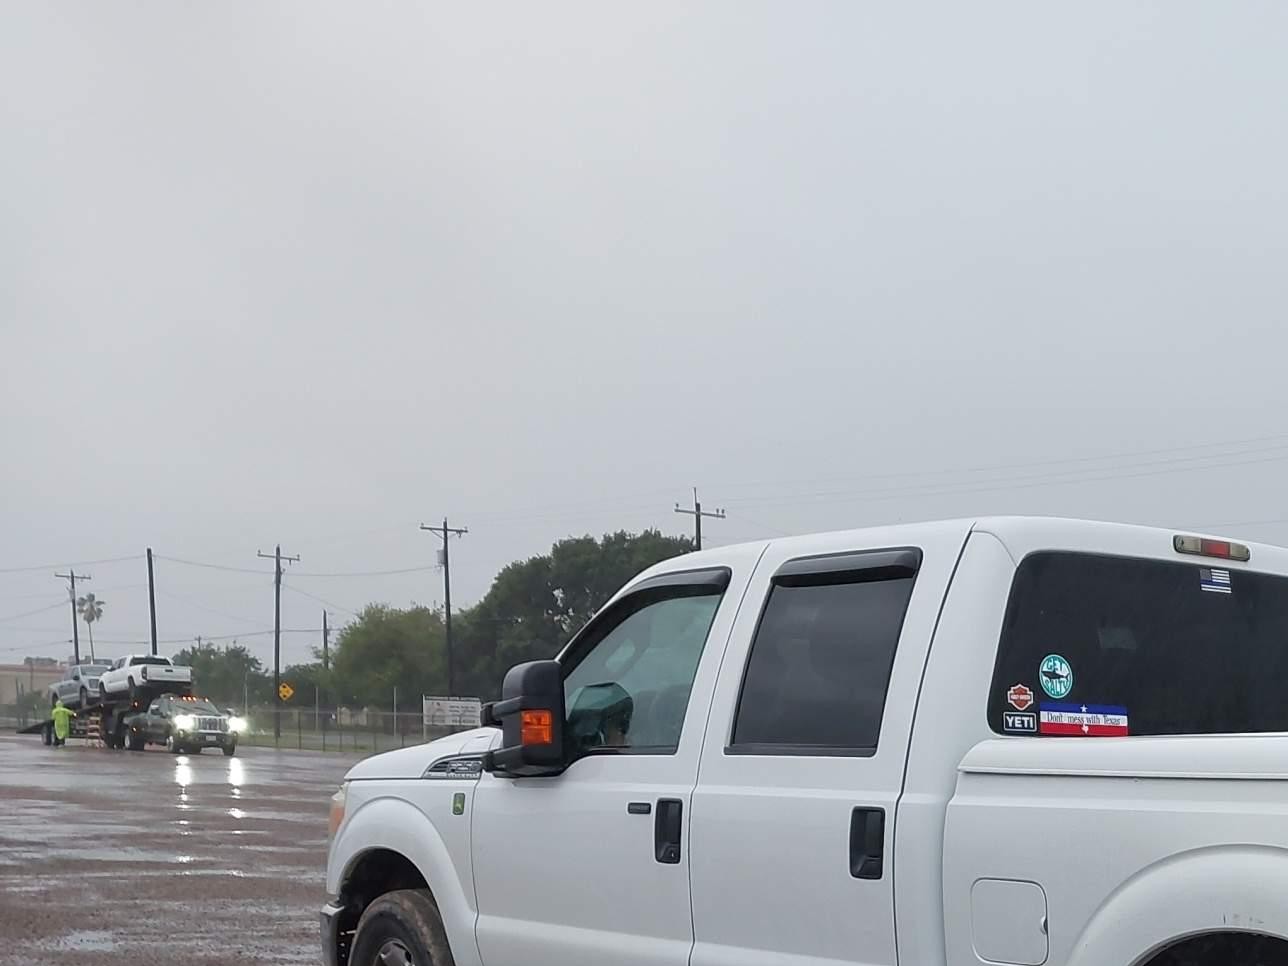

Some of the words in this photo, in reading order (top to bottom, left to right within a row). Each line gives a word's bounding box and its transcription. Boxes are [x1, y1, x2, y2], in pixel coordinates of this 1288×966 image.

[1045, 679, 1070, 696] SALTY
[1006, 716, 1034, 728] YETI
[1067, 714, 1085, 725] mess
[1086, 714, 1101, 725] with
[1103, 714, 1121, 726] Texas
